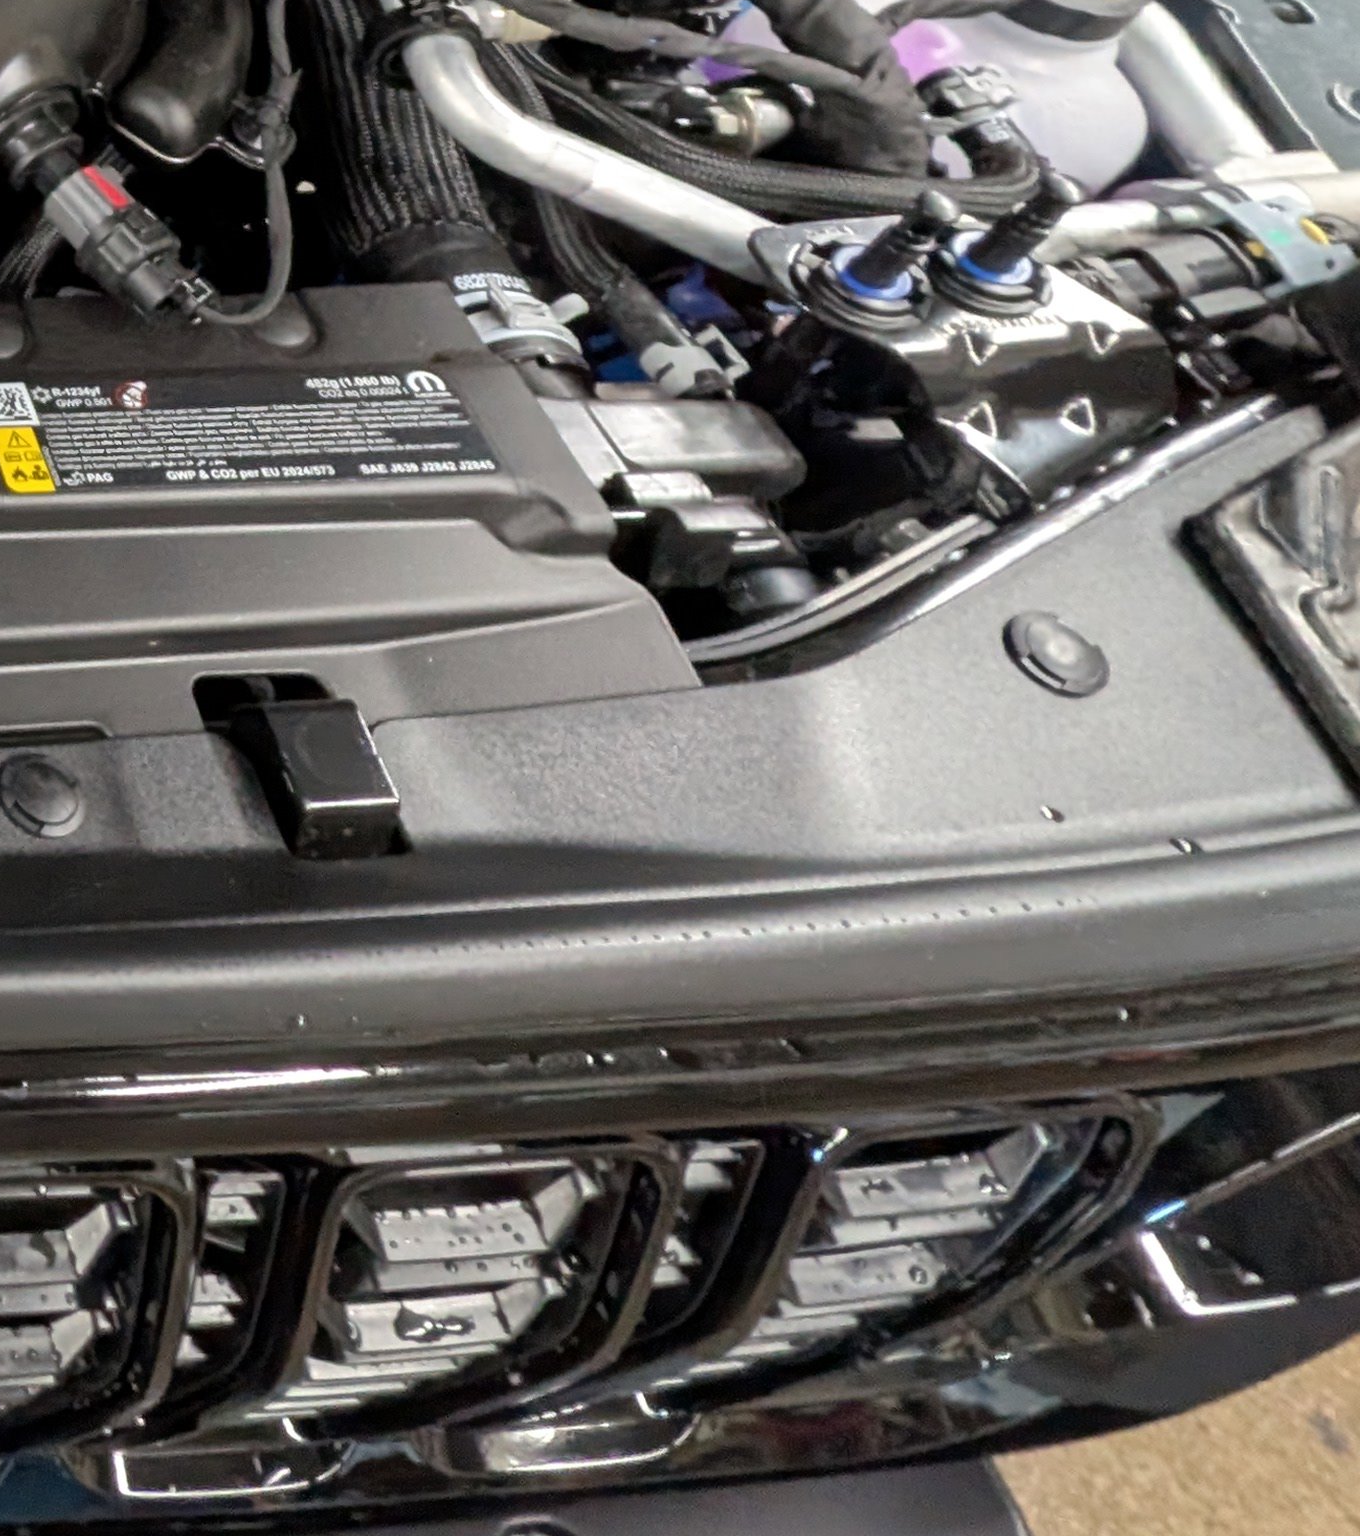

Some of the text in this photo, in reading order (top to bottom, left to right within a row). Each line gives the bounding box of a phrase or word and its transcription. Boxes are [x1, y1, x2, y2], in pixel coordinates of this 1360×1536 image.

[318, 388, 343, 399] CO2
[55, 397, 83, 407] GWP
[165, 469, 196, 481] GWP
[198, 469, 210, 480] &
[210, 468, 238, 480] CO2
[239, 469, 260, 481] per
[260, 466, 280, 478] EU
[358, 463, 389, 475] SAE
[86, 472, 114, 483] PAG
